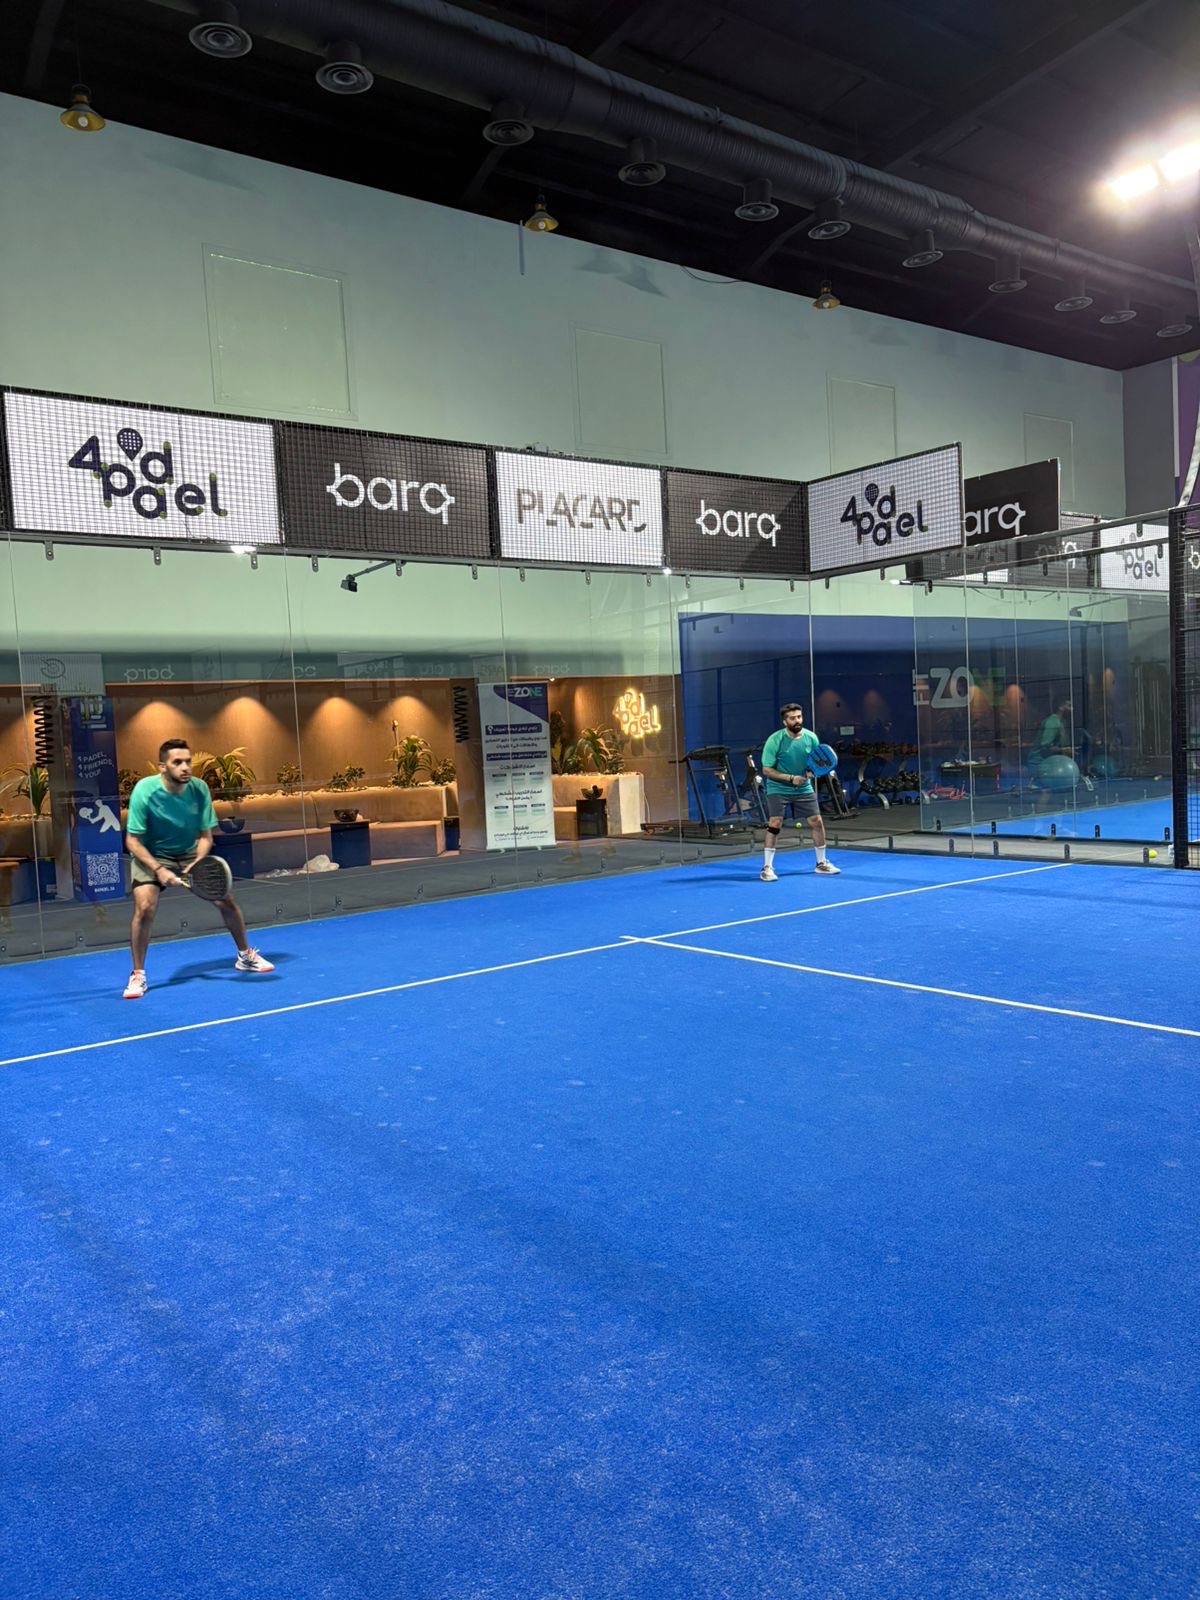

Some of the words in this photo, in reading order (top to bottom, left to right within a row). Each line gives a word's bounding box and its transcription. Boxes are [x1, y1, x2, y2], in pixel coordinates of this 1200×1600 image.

[326, 463, 455, 525] barq
[695, 500, 782, 547] barq
[965, 501, 1026, 536] arq
